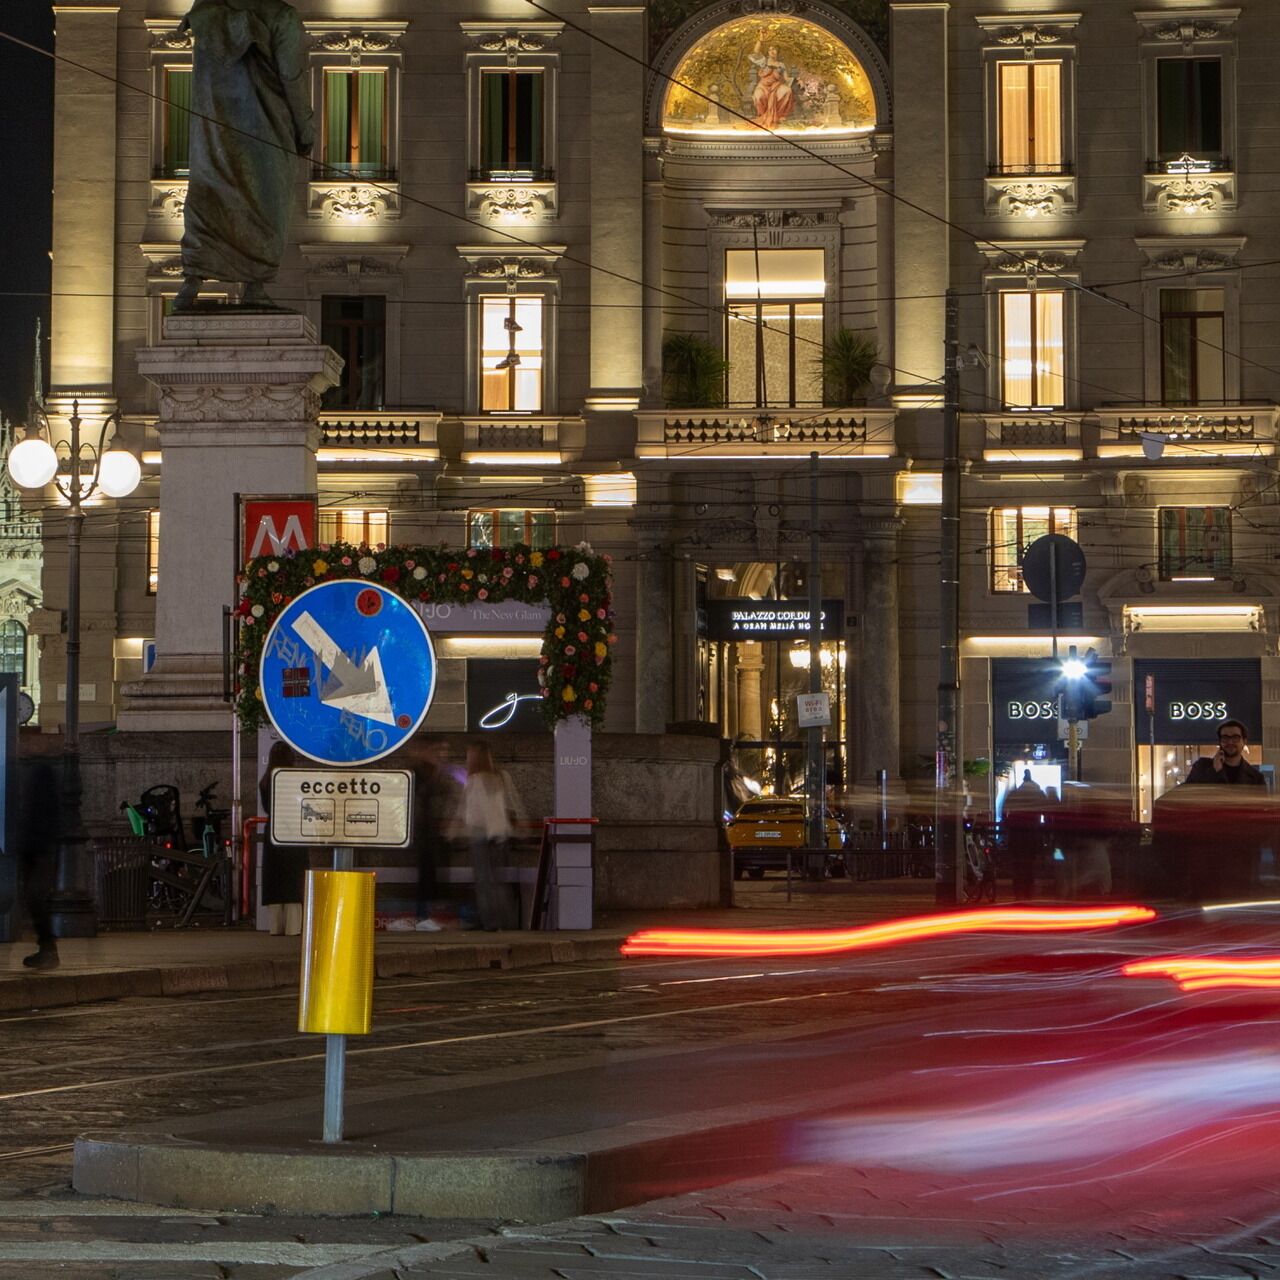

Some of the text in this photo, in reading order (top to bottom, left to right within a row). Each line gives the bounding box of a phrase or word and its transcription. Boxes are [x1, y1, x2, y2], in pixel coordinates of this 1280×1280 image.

[249, 514, 308, 558] M
[471, 608, 490, 619] The
[491, 609, 514, 619] New
[515, 608, 542, 619] Glam
[731, 611, 776, 621] PALAZZO
[1170, 701, 1228, 720] BOSS
[300, 778, 381, 795] eccetto
